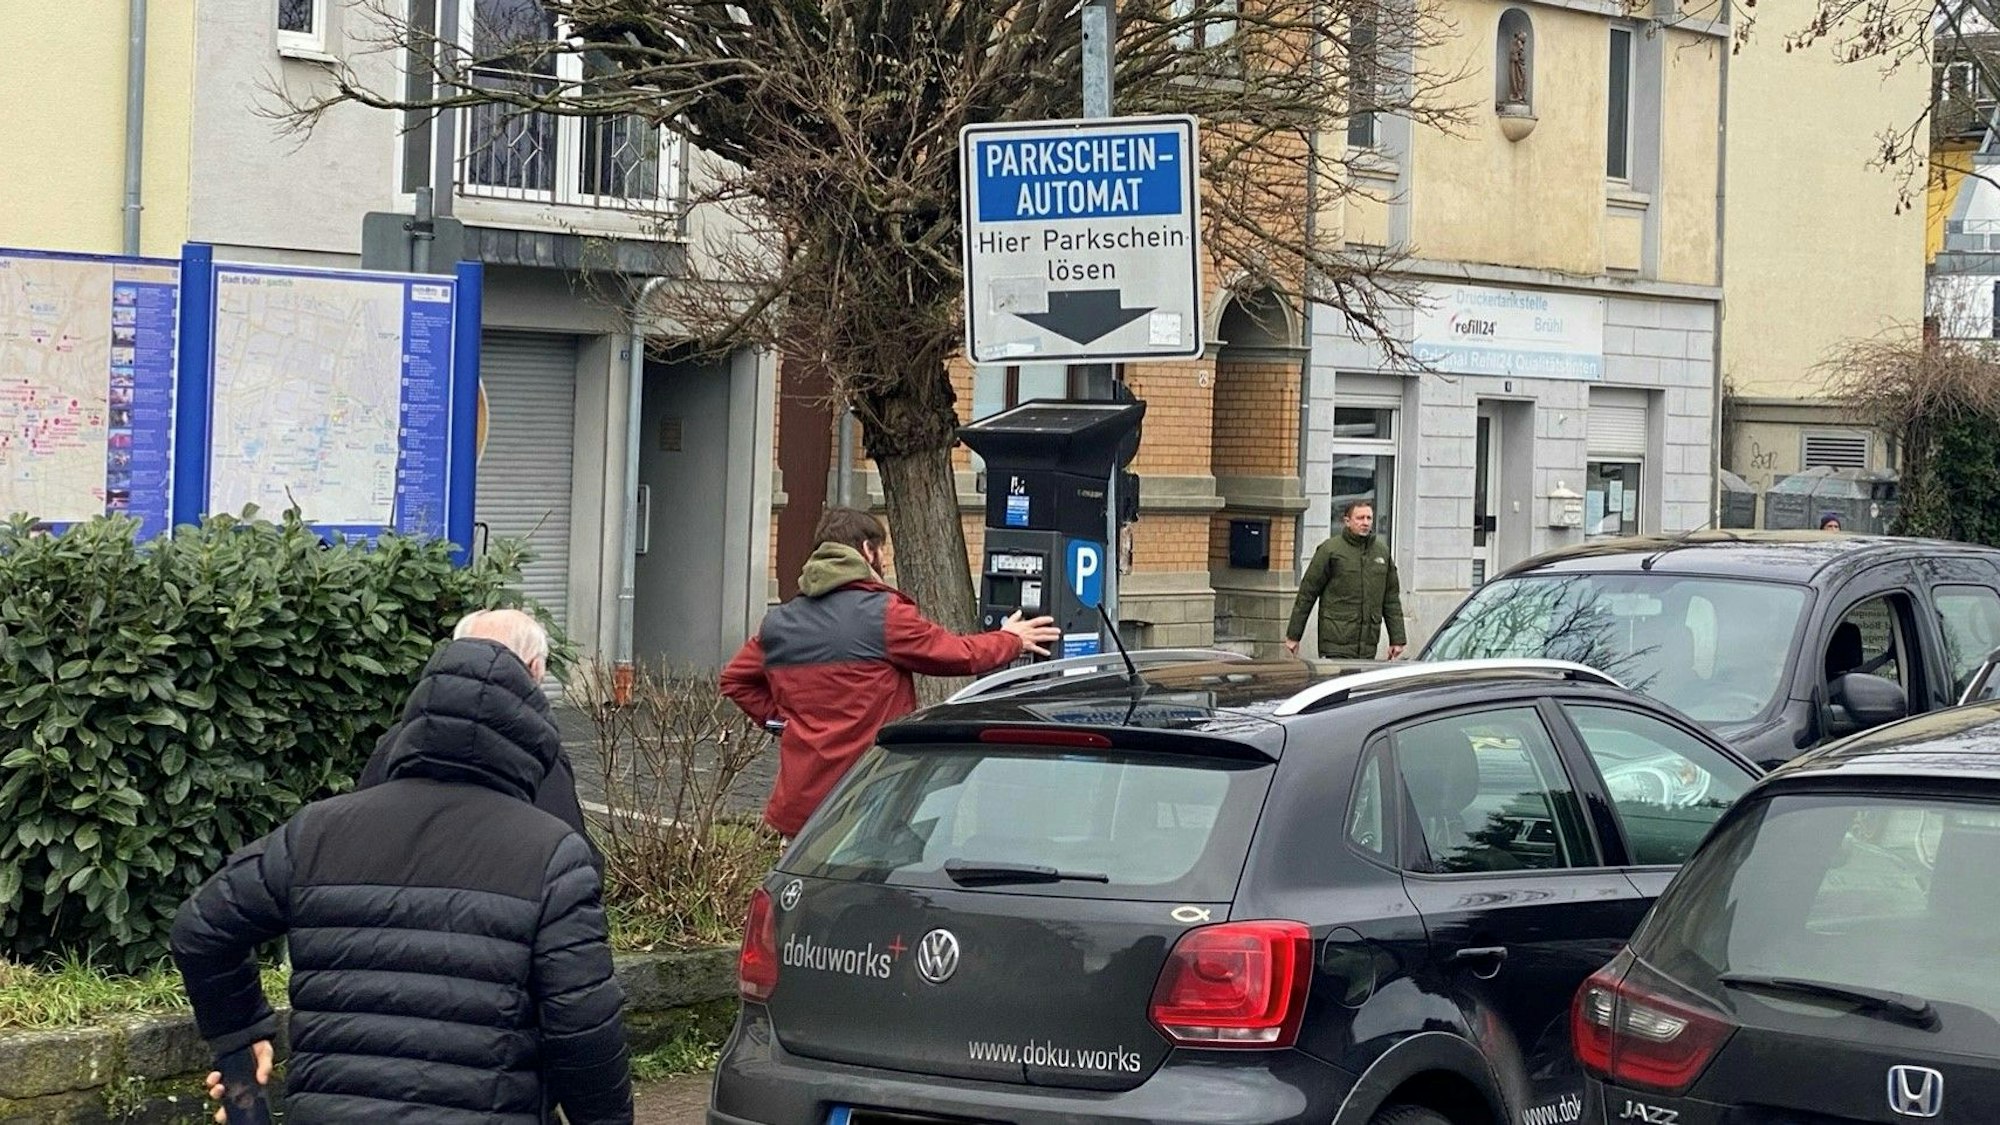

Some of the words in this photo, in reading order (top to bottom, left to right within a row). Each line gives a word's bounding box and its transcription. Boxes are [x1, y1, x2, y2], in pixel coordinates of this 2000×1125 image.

[986, 137, 1174, 178] PARKSCHEIN-
[1016, 178, 1143, 216] AUTOMAT
[978, 231, 1031, 253] Hier
[1043, 225, 1184, 252] Parkschein
[1048, 259, 1115, 281] lösen
[1456, 289, 1549, 312] Druckertankstelle
[1534, 316, 1563, 333] Brühl
[1075, 547, 1098, 596] P
[968, 1040, 1141, 1073] www.doku.works
[1620, 1100, 1679, 1125] JAZZ
